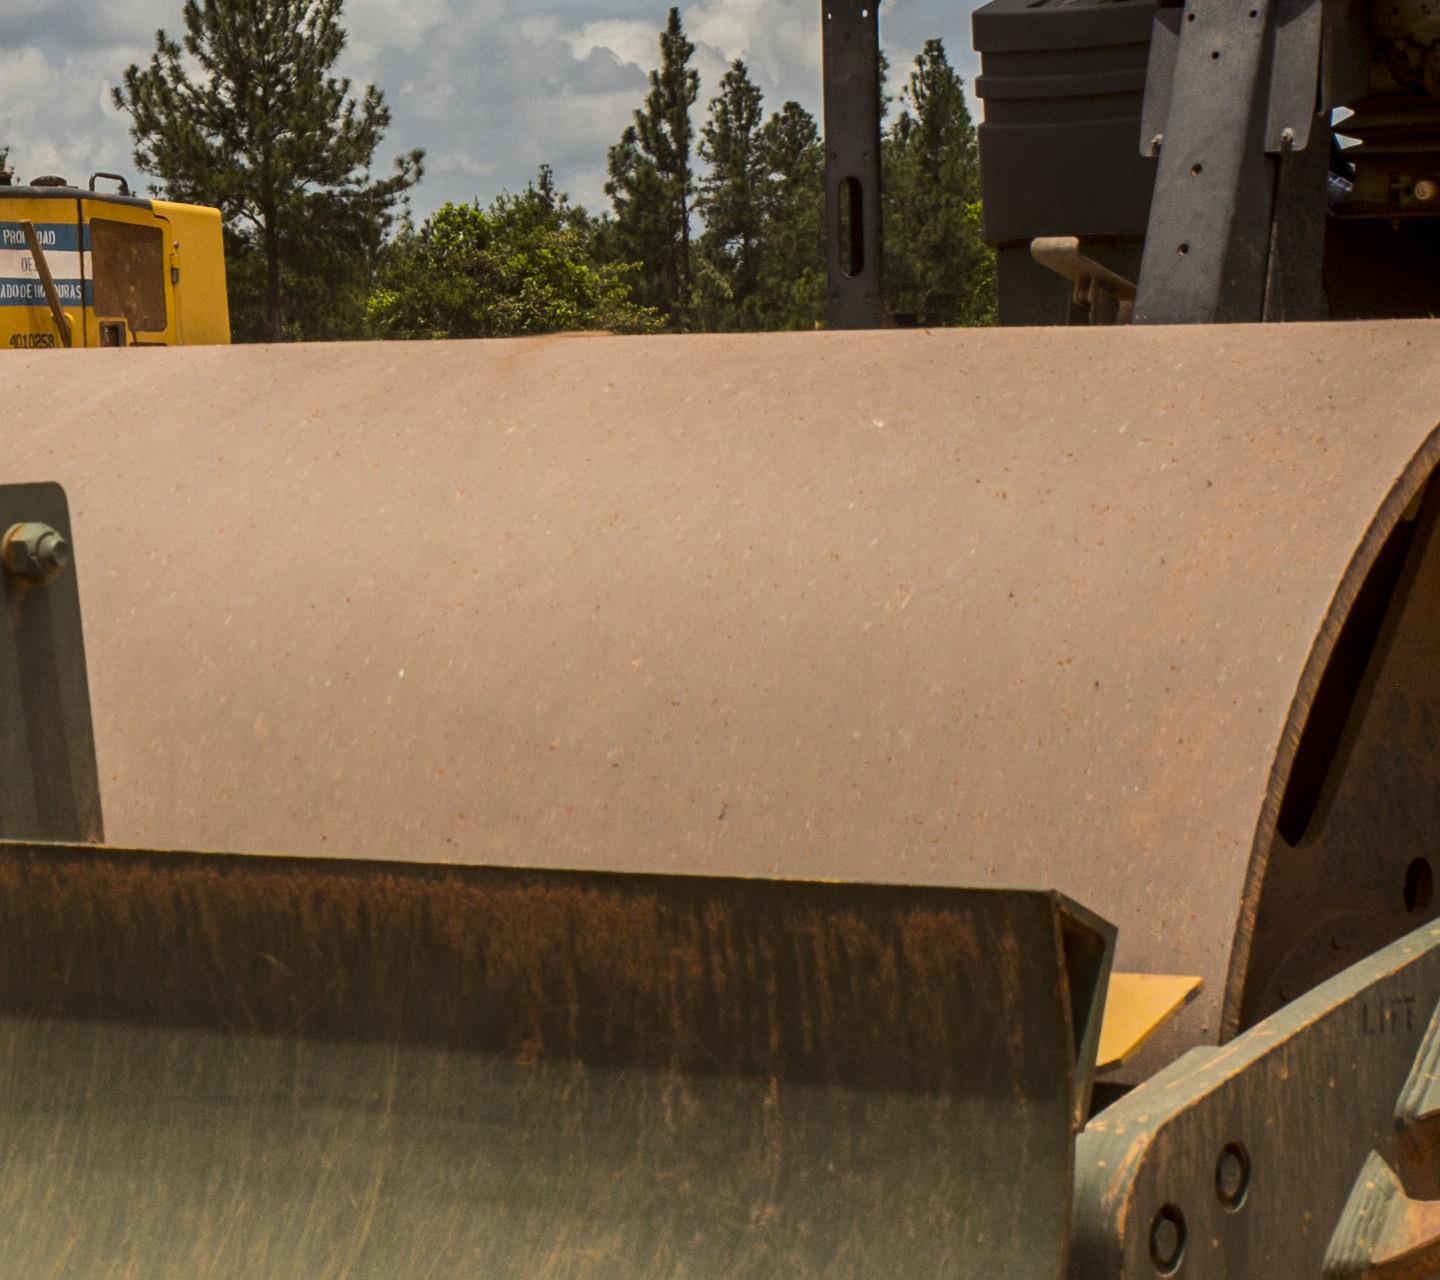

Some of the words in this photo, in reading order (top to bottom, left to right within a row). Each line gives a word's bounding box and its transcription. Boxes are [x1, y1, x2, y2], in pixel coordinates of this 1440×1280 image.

[2, 229, 56, 245] PRODAD
[21, 283, 32, 299] DE
[34, 283, 82, 299] HOURAS
[8, 333, 56, 348] 4010258
